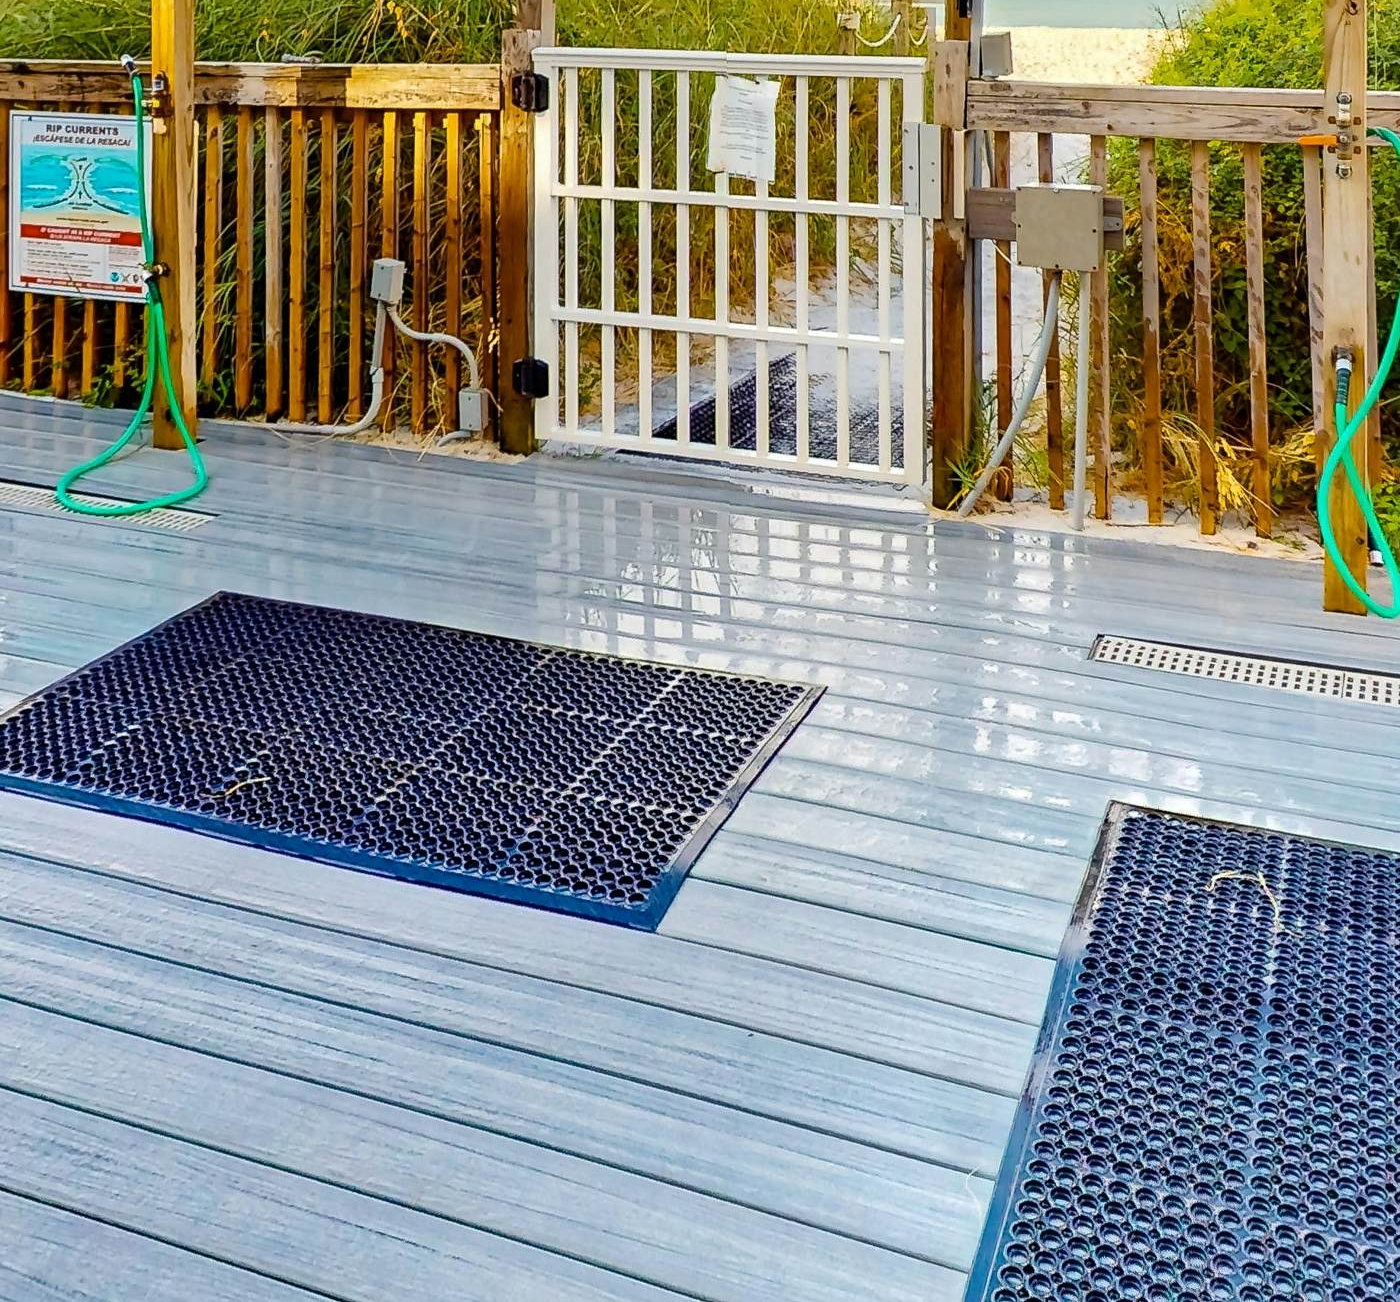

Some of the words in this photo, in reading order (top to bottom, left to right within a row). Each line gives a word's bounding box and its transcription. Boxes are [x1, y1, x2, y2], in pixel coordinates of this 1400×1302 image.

[46, 124, 62, 133] RIP
[65, 125, 119, 136] CURRENTS
[75, 136, 85, 144] DE
[86, 137, 96, 145] LA
